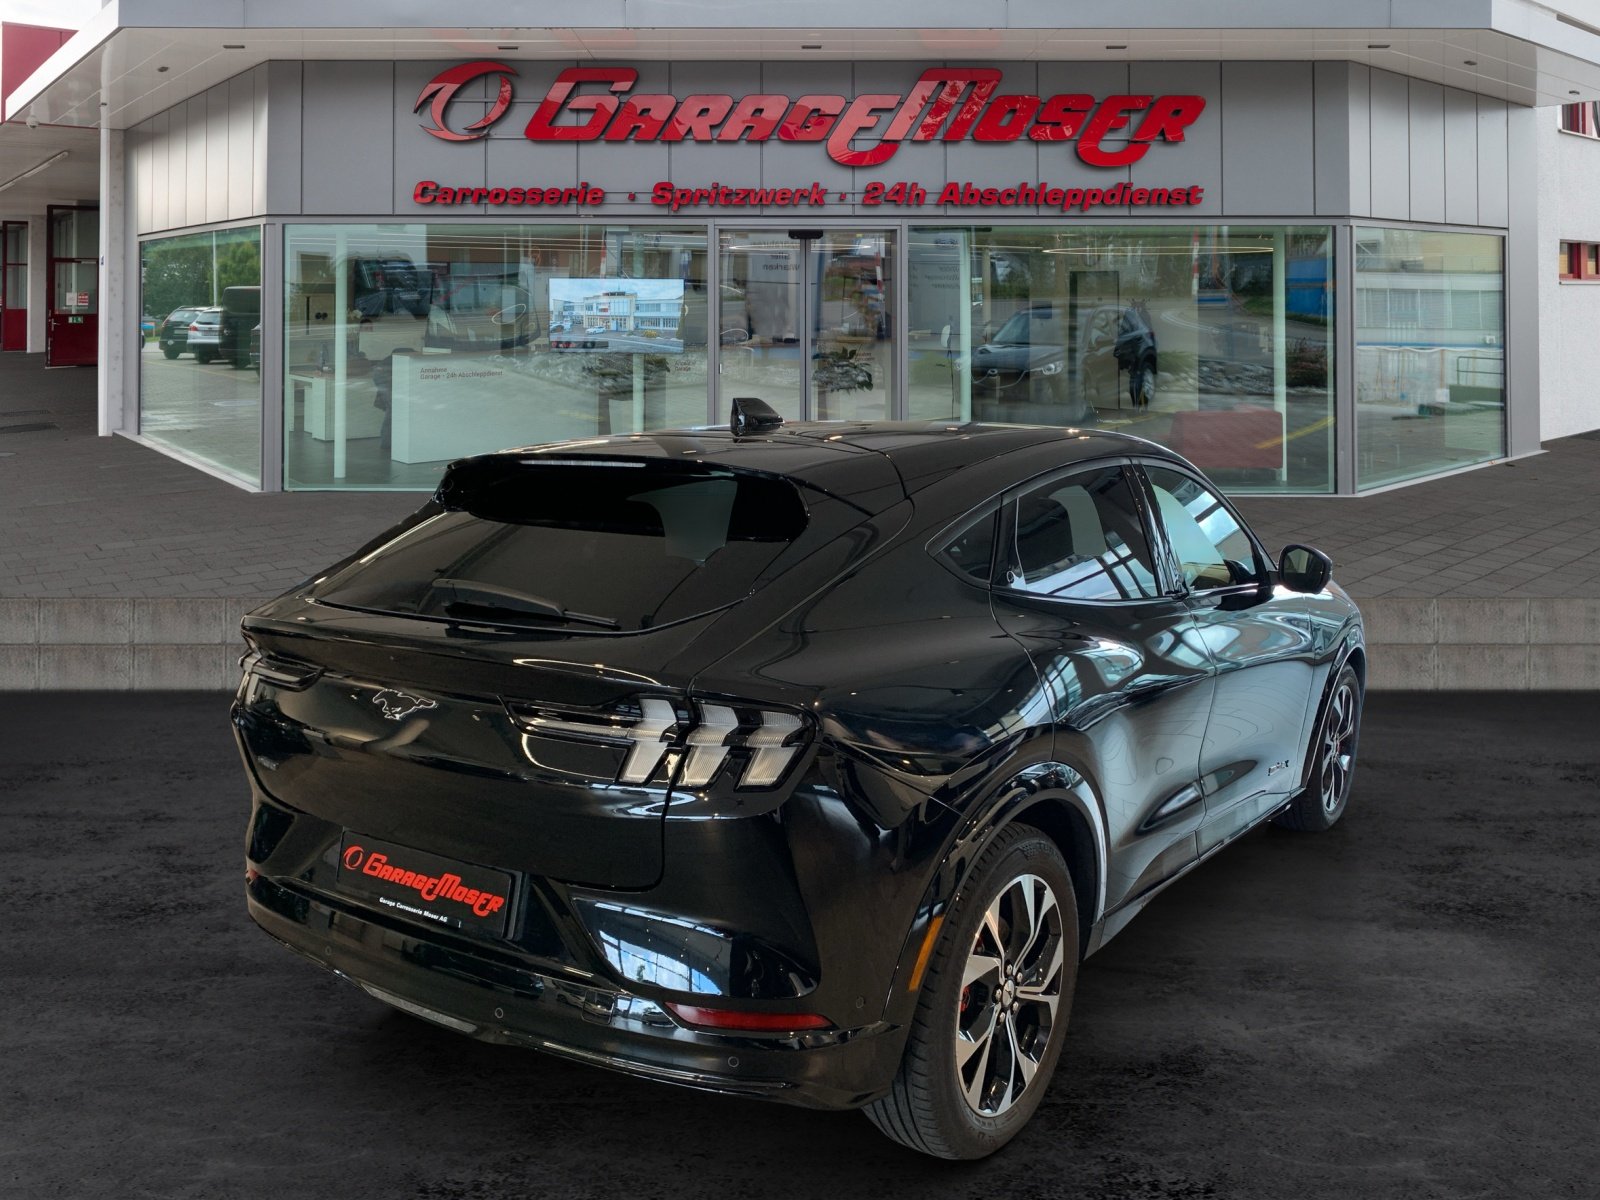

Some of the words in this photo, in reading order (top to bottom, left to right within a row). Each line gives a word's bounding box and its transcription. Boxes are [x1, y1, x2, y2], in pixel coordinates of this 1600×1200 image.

[413, 180, 605, 206] Carrosserie
[651, 180, 826, 211] Spritzwerk
[862, 181, 927, 206] 24h
[936, 181, 1205, 211] Abschleppdienst
[379, 896, 396, 907] Garage
[396, 902, 423, 915] Carrosserie
[423, 910, 439, 920] Moser
[438, 915, 448, 923] AG
